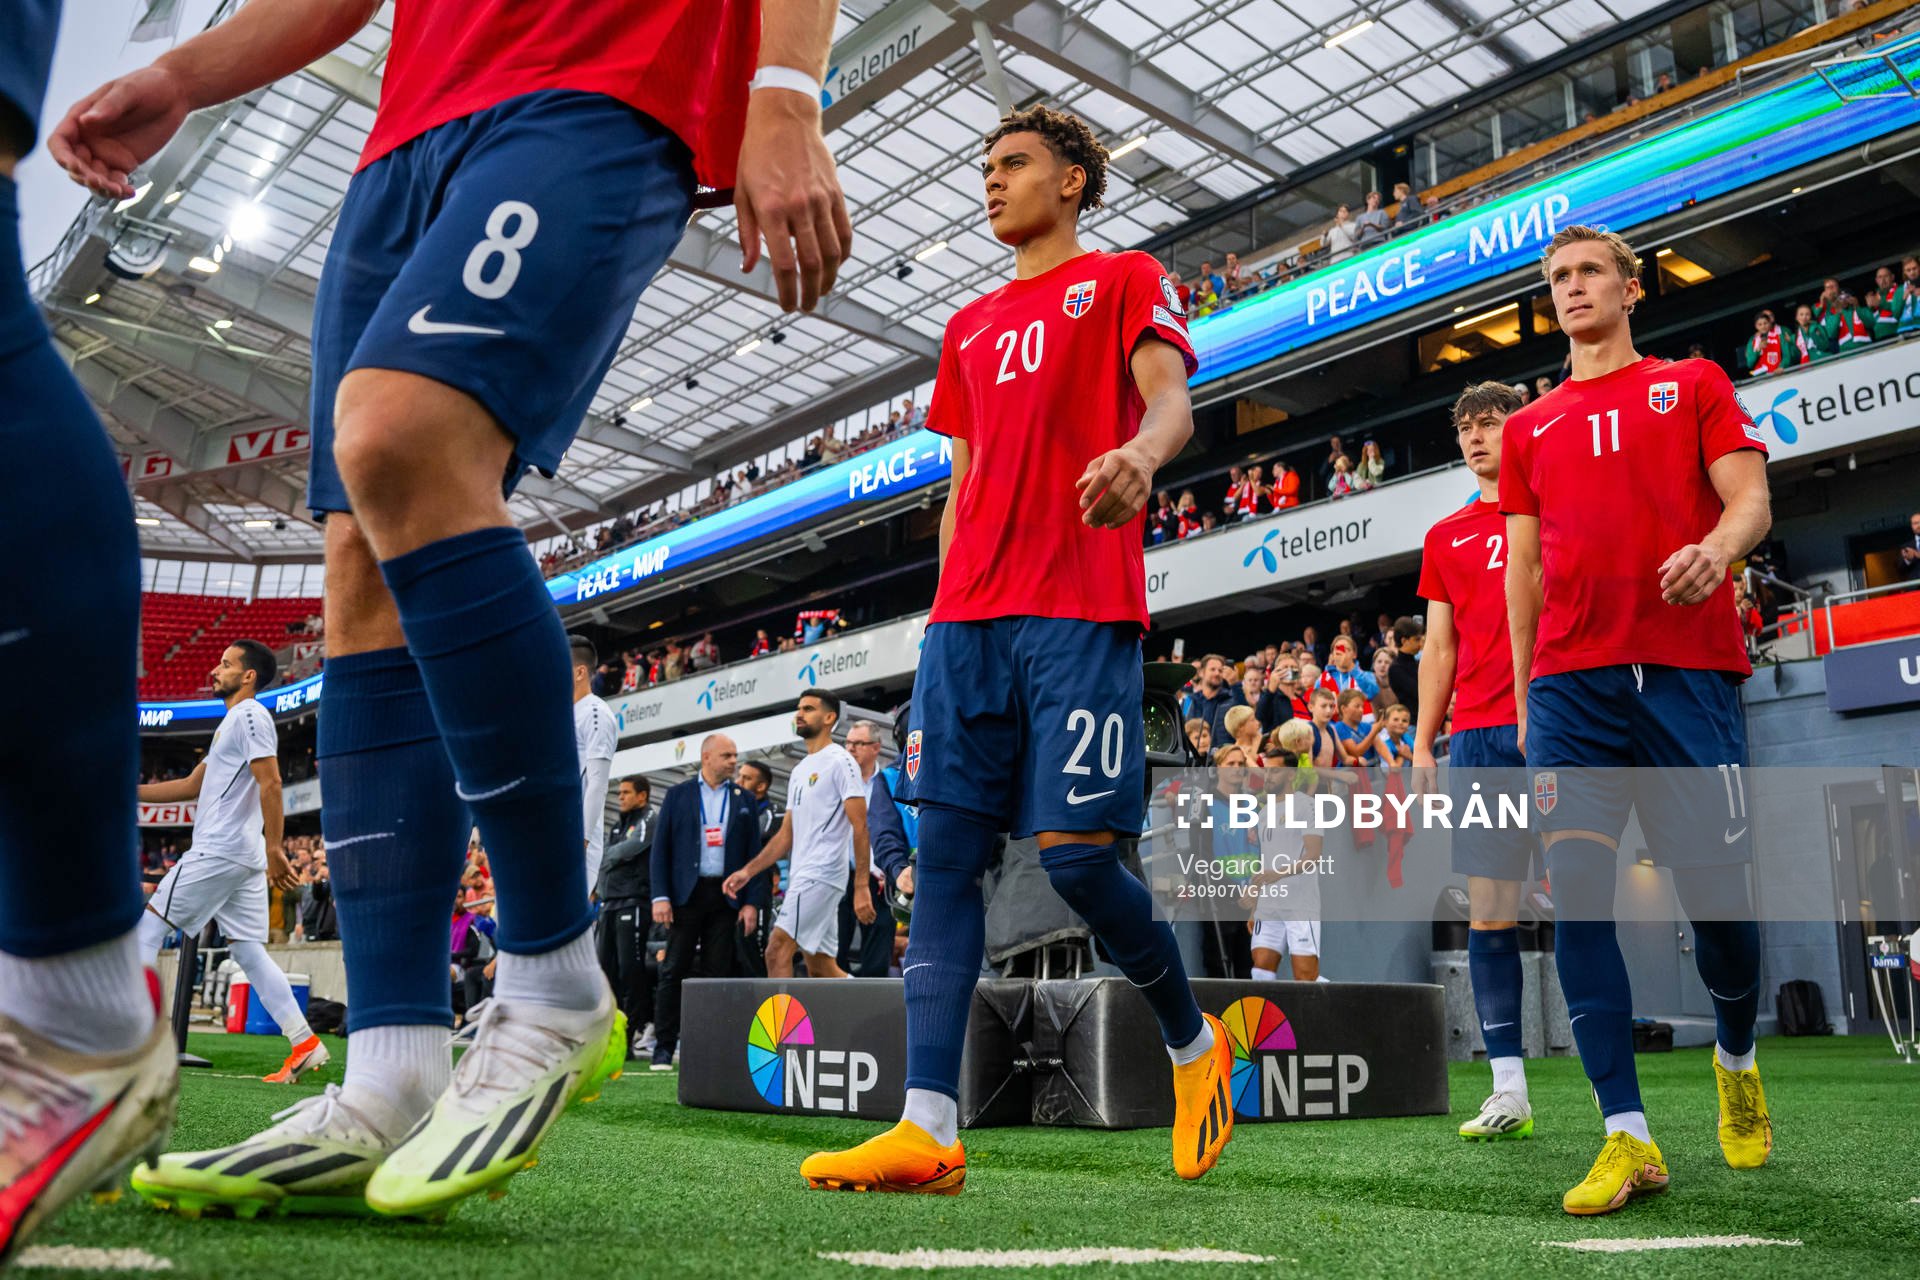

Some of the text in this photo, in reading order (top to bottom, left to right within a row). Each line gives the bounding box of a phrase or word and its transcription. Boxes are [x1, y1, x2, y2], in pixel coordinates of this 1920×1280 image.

[839, 25, 922, 97] telenor
[462, 200, 539, 300] 8
[1306, 248, 1426, 326] PEACE
[995, 319, 1045, 386] 20
[1798, 372, 1920, 426] teleno
[233, 426, 311, 460] VG
[1587, 409, 1620, 457] 11
[849, 447, 918, 499] PEACE
[1280, 518, 1372, 559] telenor
[1485, 534, 1509, 571] 2
[577, 564, 620, 602] PEACE
[818, 649, 869, 676] telenor
[625, 702, 663, 725] telenor
[713, 677, 758, 703] telenor
[1062, 709, 1124, 778] 20
[138, 805, 178, 824] VG
[1717, 763, 1746, 819] 11
[785, 1049, 879, 1112] NEP
[1262, 1054, 1369, 1117] NEP
